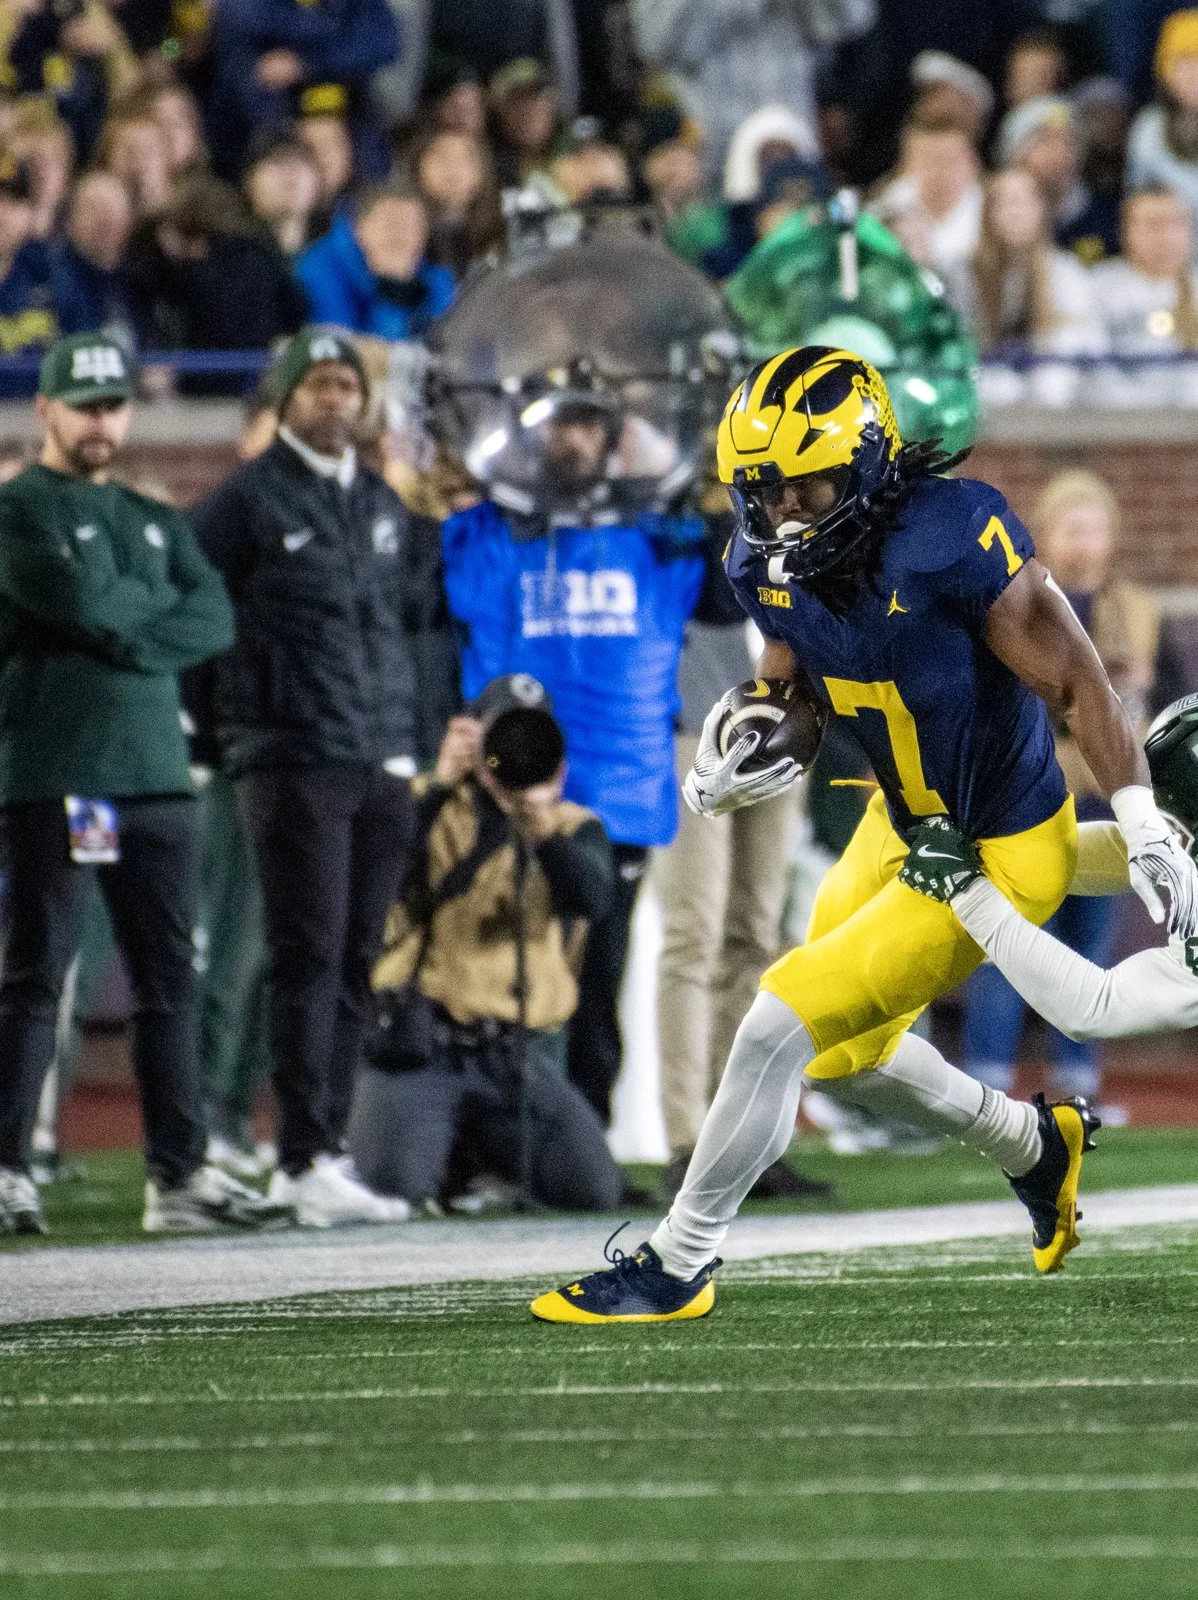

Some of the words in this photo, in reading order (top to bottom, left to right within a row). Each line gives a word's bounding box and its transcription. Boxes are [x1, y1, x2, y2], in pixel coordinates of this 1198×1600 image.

[745, 467, 760, 480] M
[977, 515, 1023, 576] 7
[822, 676, 949, 816] 7
[567, 1283, 584, 1296] M
